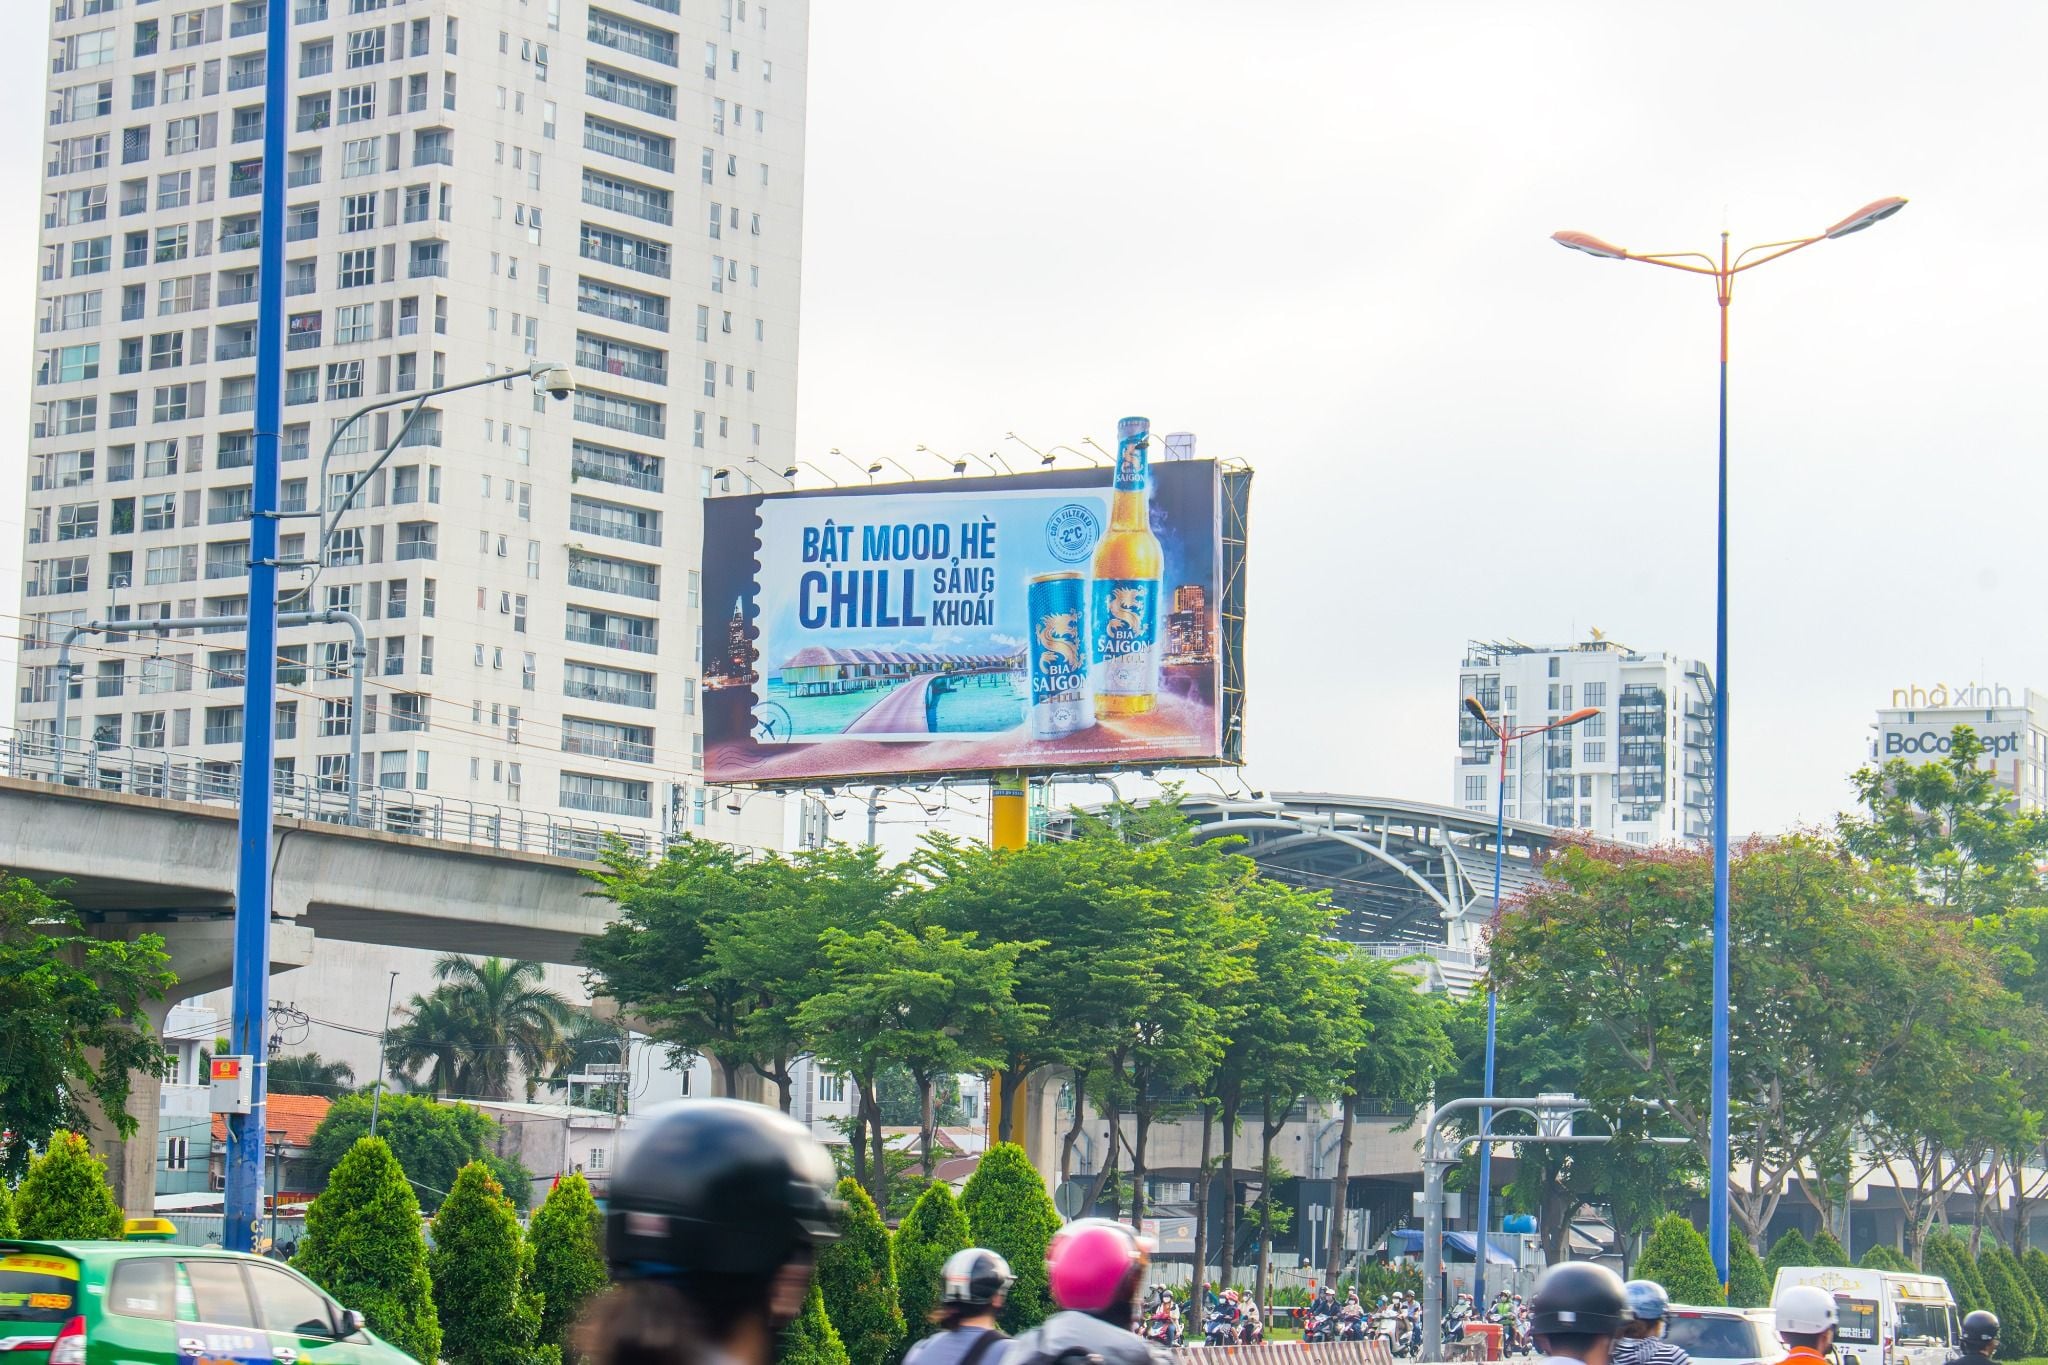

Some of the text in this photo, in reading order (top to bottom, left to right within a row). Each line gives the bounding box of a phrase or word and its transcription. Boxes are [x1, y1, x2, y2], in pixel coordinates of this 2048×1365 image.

[1050, 510, 1092, 536] COLD FILTERED
[802, 514, 996, 568] BẬT MOOD HÈ
[933, 556, 995, 594] SẢNG
[799, 569, 926, 629] CHILL
[932, 593, 995, 627] KHOÁI
[1097, 639, 1151, 654] SAIGON
[1116, 630, 1133, 640] BIA
[1049, 664, 1070, 675] BIA
[1033, 674, 1087, 692] SAIGON
[1892, 682, 1948, 707] nhà
[1886, 731, 2018, 758] BoCoept
